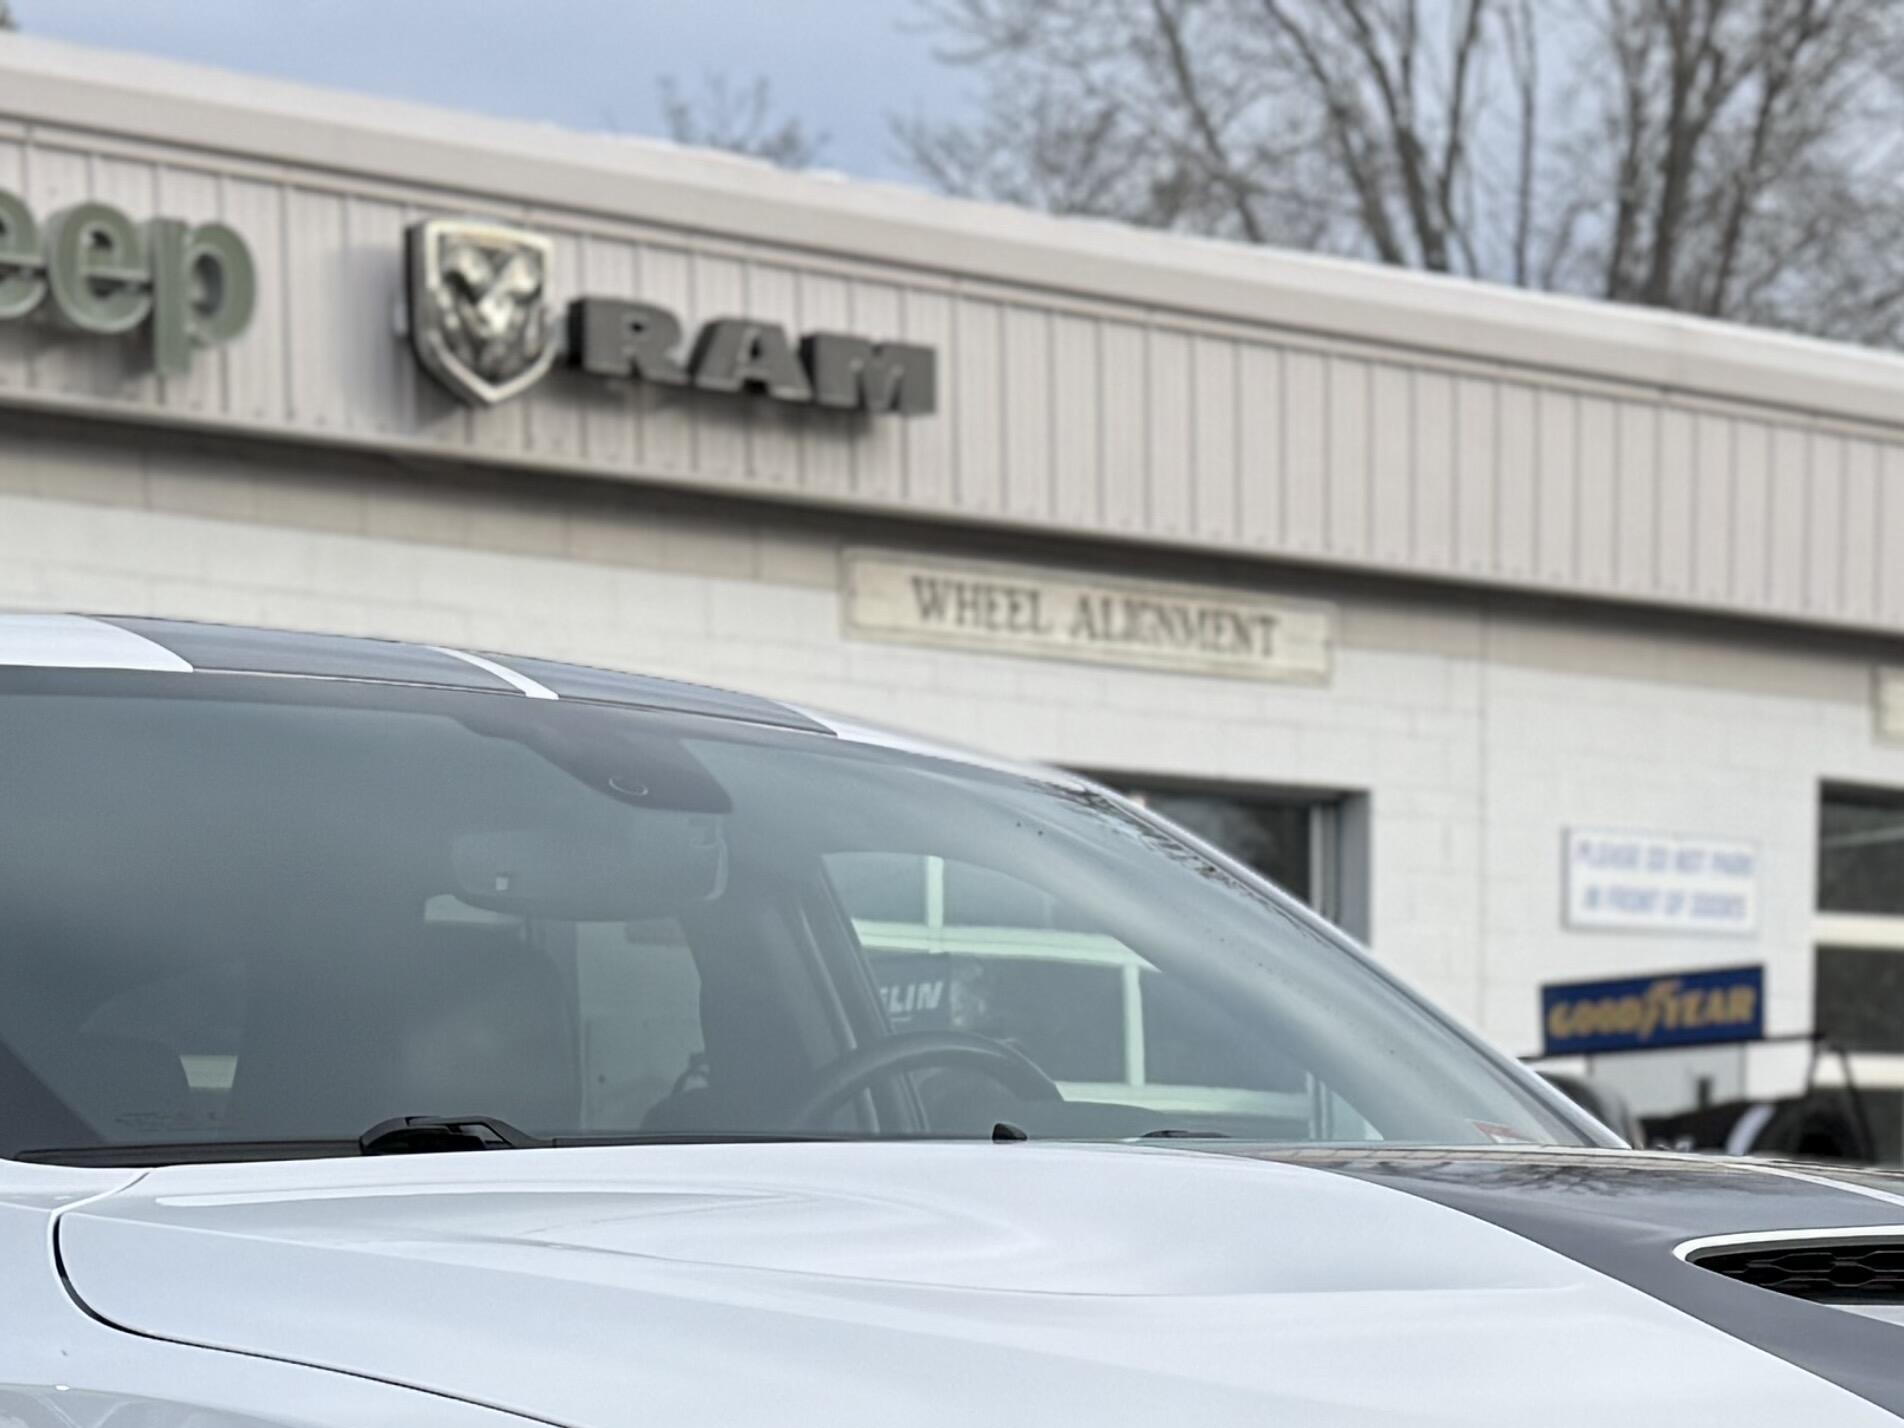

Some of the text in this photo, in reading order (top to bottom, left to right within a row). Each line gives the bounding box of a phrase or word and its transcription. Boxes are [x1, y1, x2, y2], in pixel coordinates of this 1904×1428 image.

[569, 297, 937, 414] RAM
[910, 574, 1053, 636] WHEEL
[1548, 979, 1757, 1041] GOODYEAR
